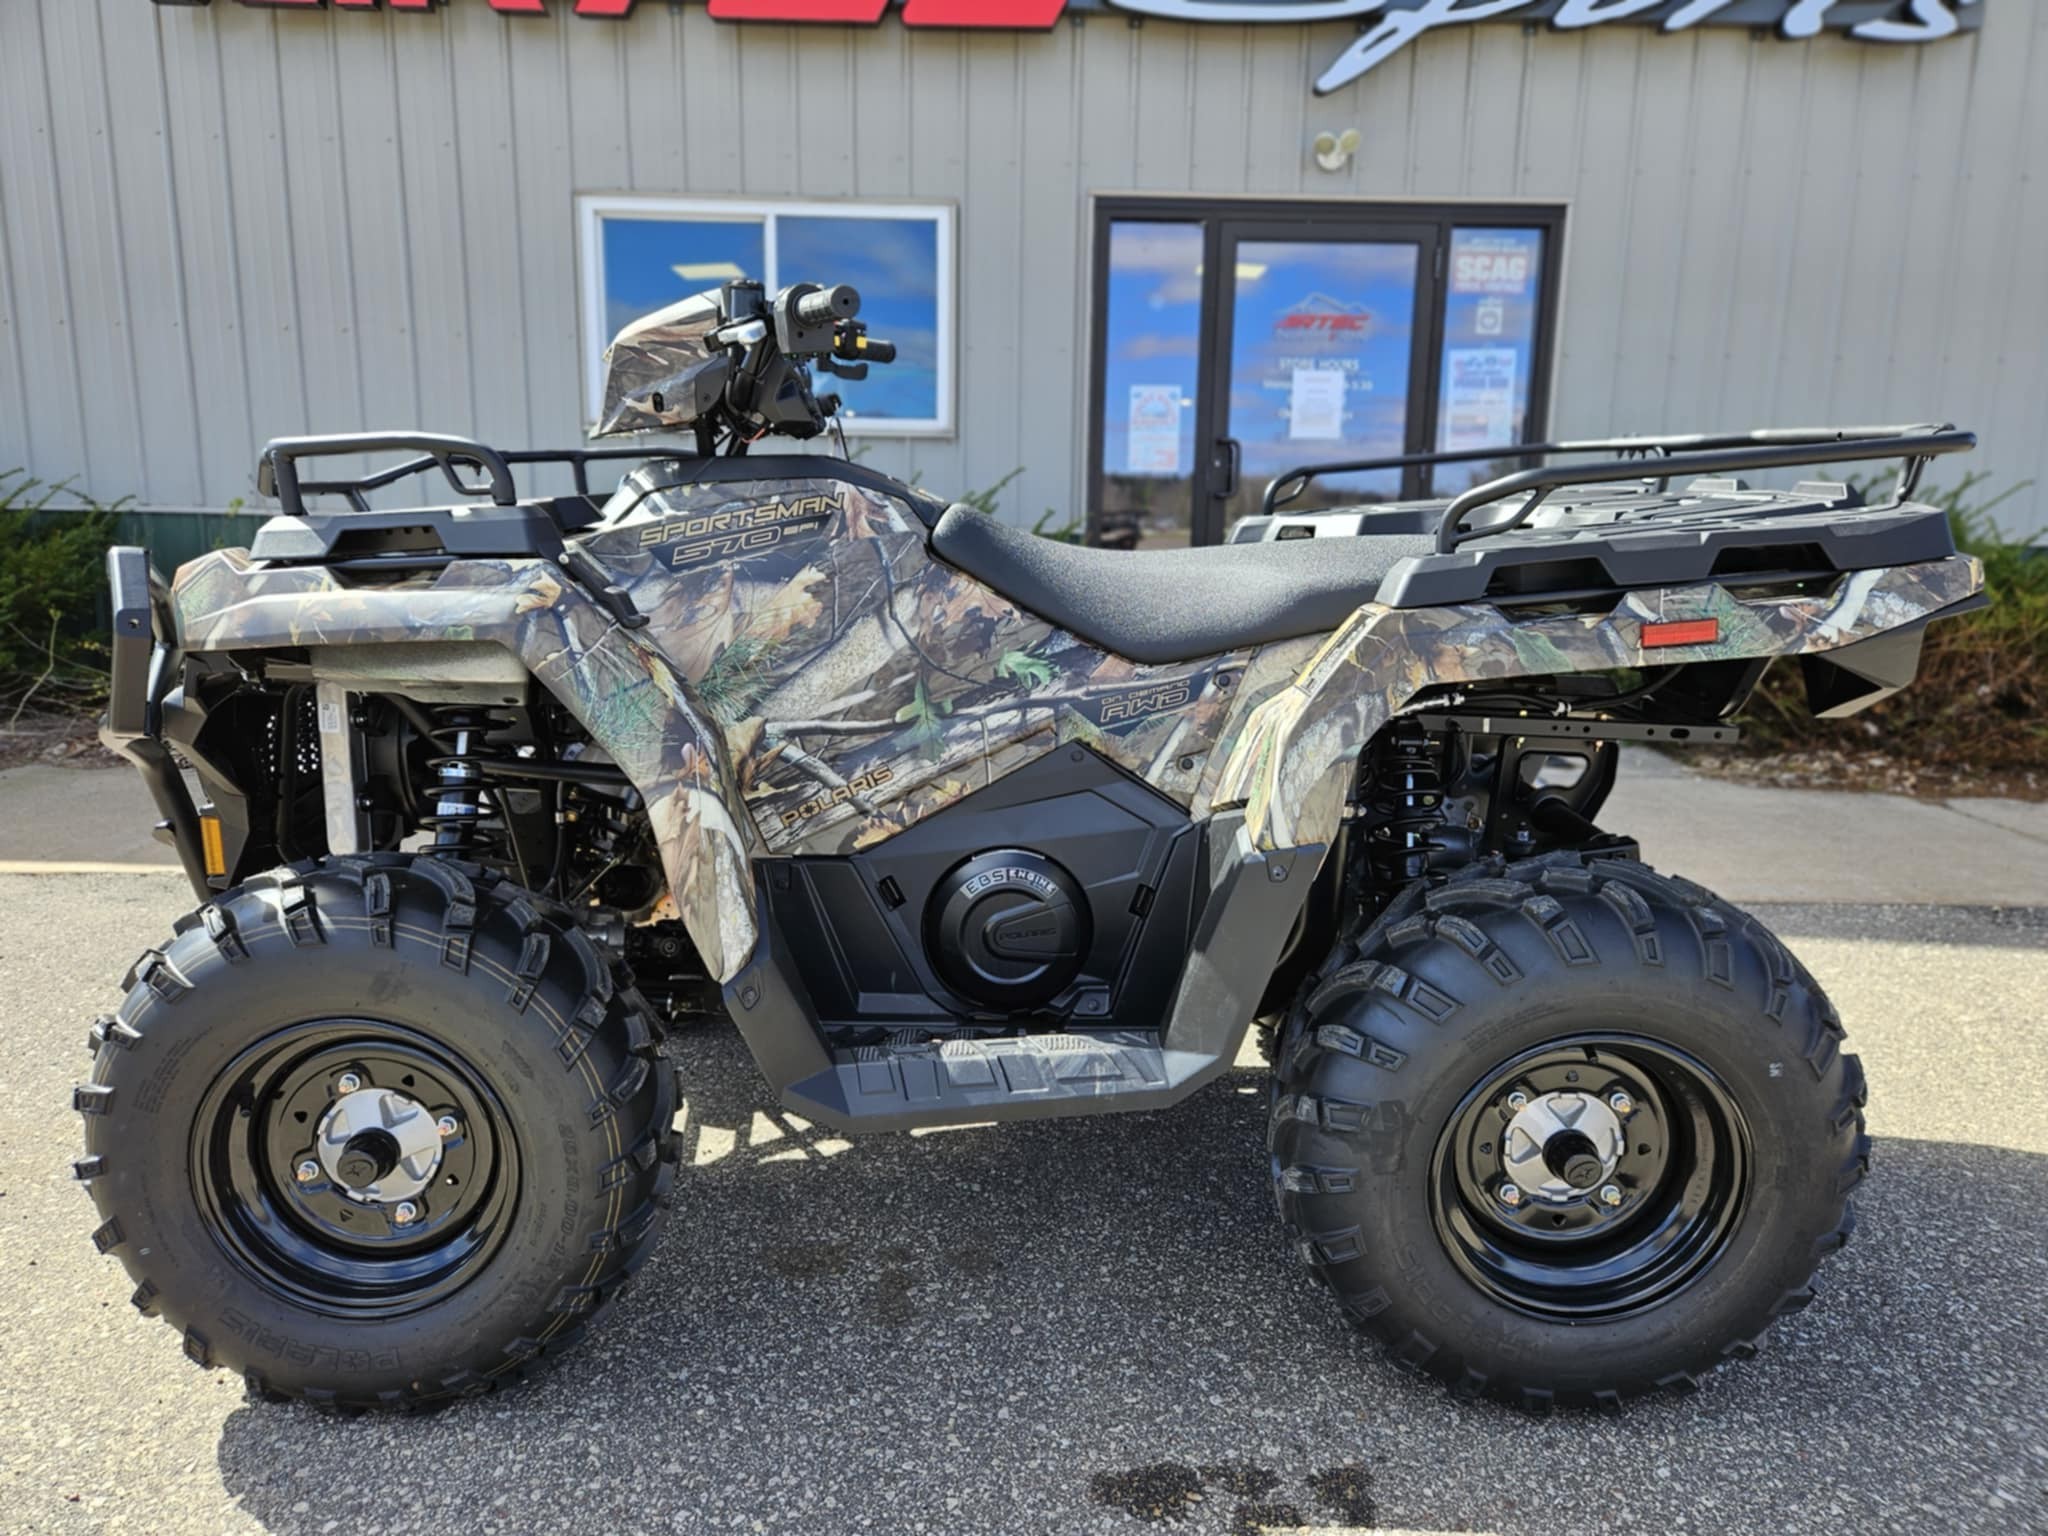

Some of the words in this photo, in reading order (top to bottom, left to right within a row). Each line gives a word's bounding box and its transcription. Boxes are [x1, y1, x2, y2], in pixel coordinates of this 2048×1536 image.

[639, 492, 845, 547] SPORTSMAN
[671, 526, 782, 566] 570
[1100, 687, 1191, 723] AWD
[781, 765, 894, 828] POLARIS
[965, 869, 1005, 894] EBS
